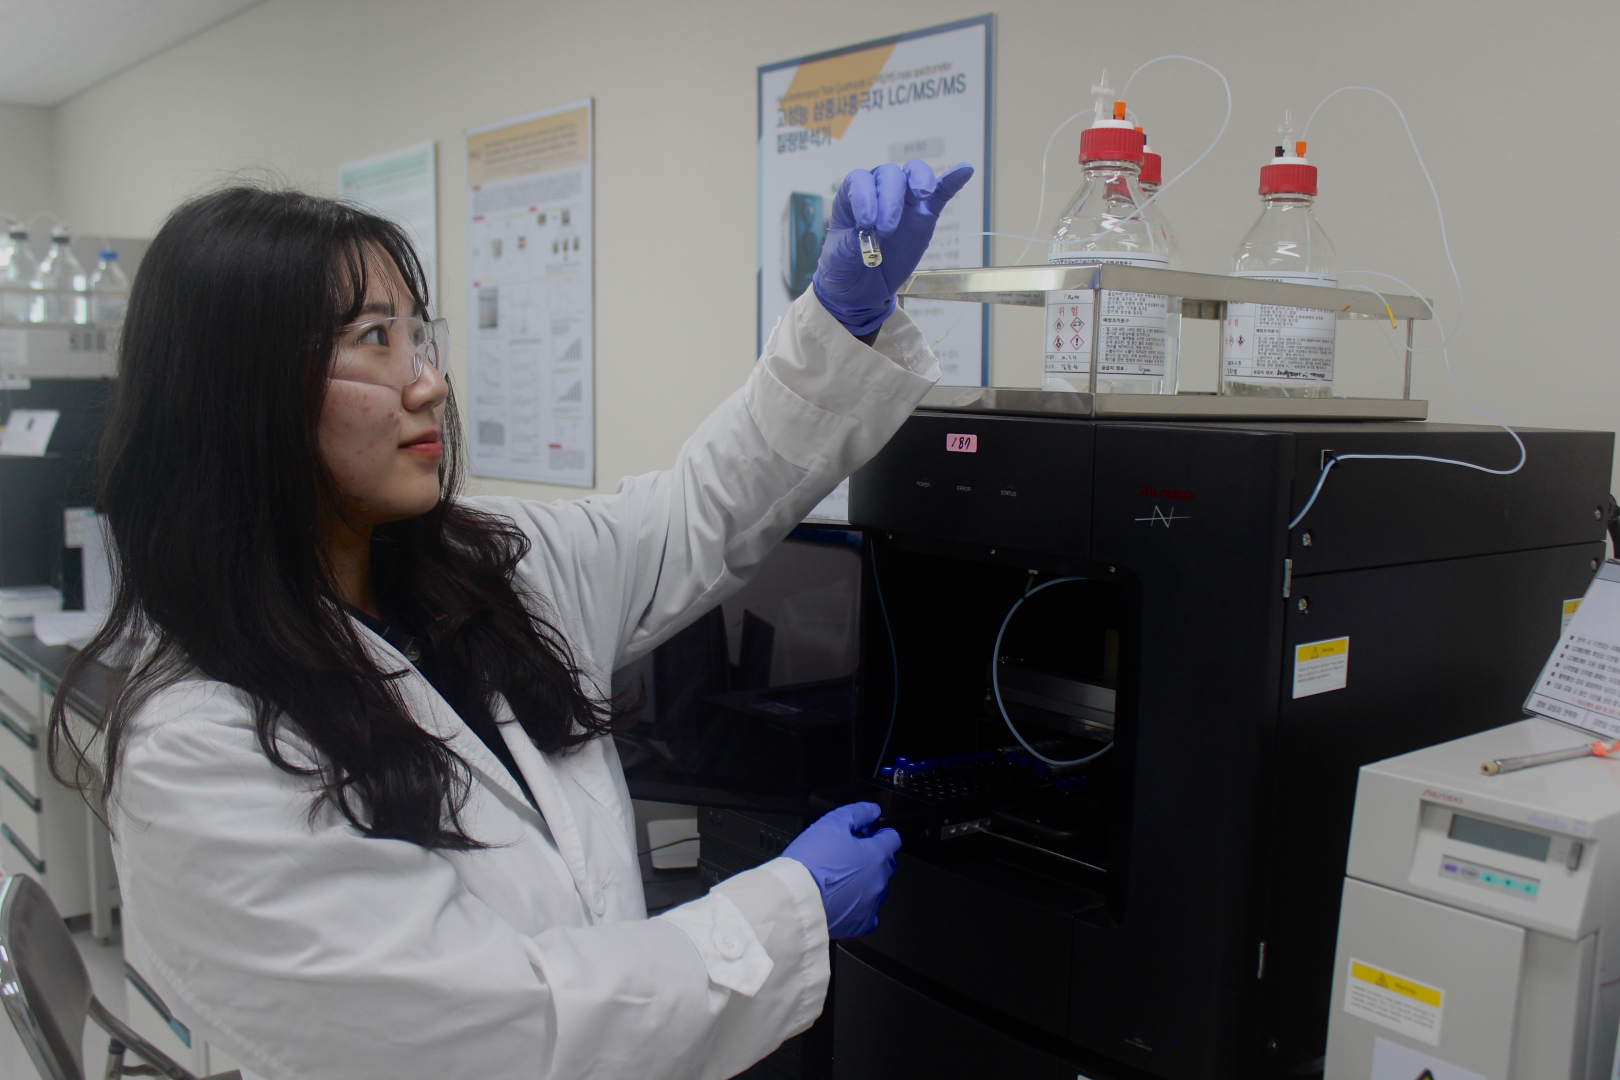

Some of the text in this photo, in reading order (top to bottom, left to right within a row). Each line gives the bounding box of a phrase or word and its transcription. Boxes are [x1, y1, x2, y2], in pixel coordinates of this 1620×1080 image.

[776, 72, 967, 128] 고성능 삼중사중극자 LC/MS/MS
[776, 125, 832, 154] 질량분석기
[1058, 306, 1078, 316] 위 험
[1136, 485, 1194, 501] SHISEIDO
